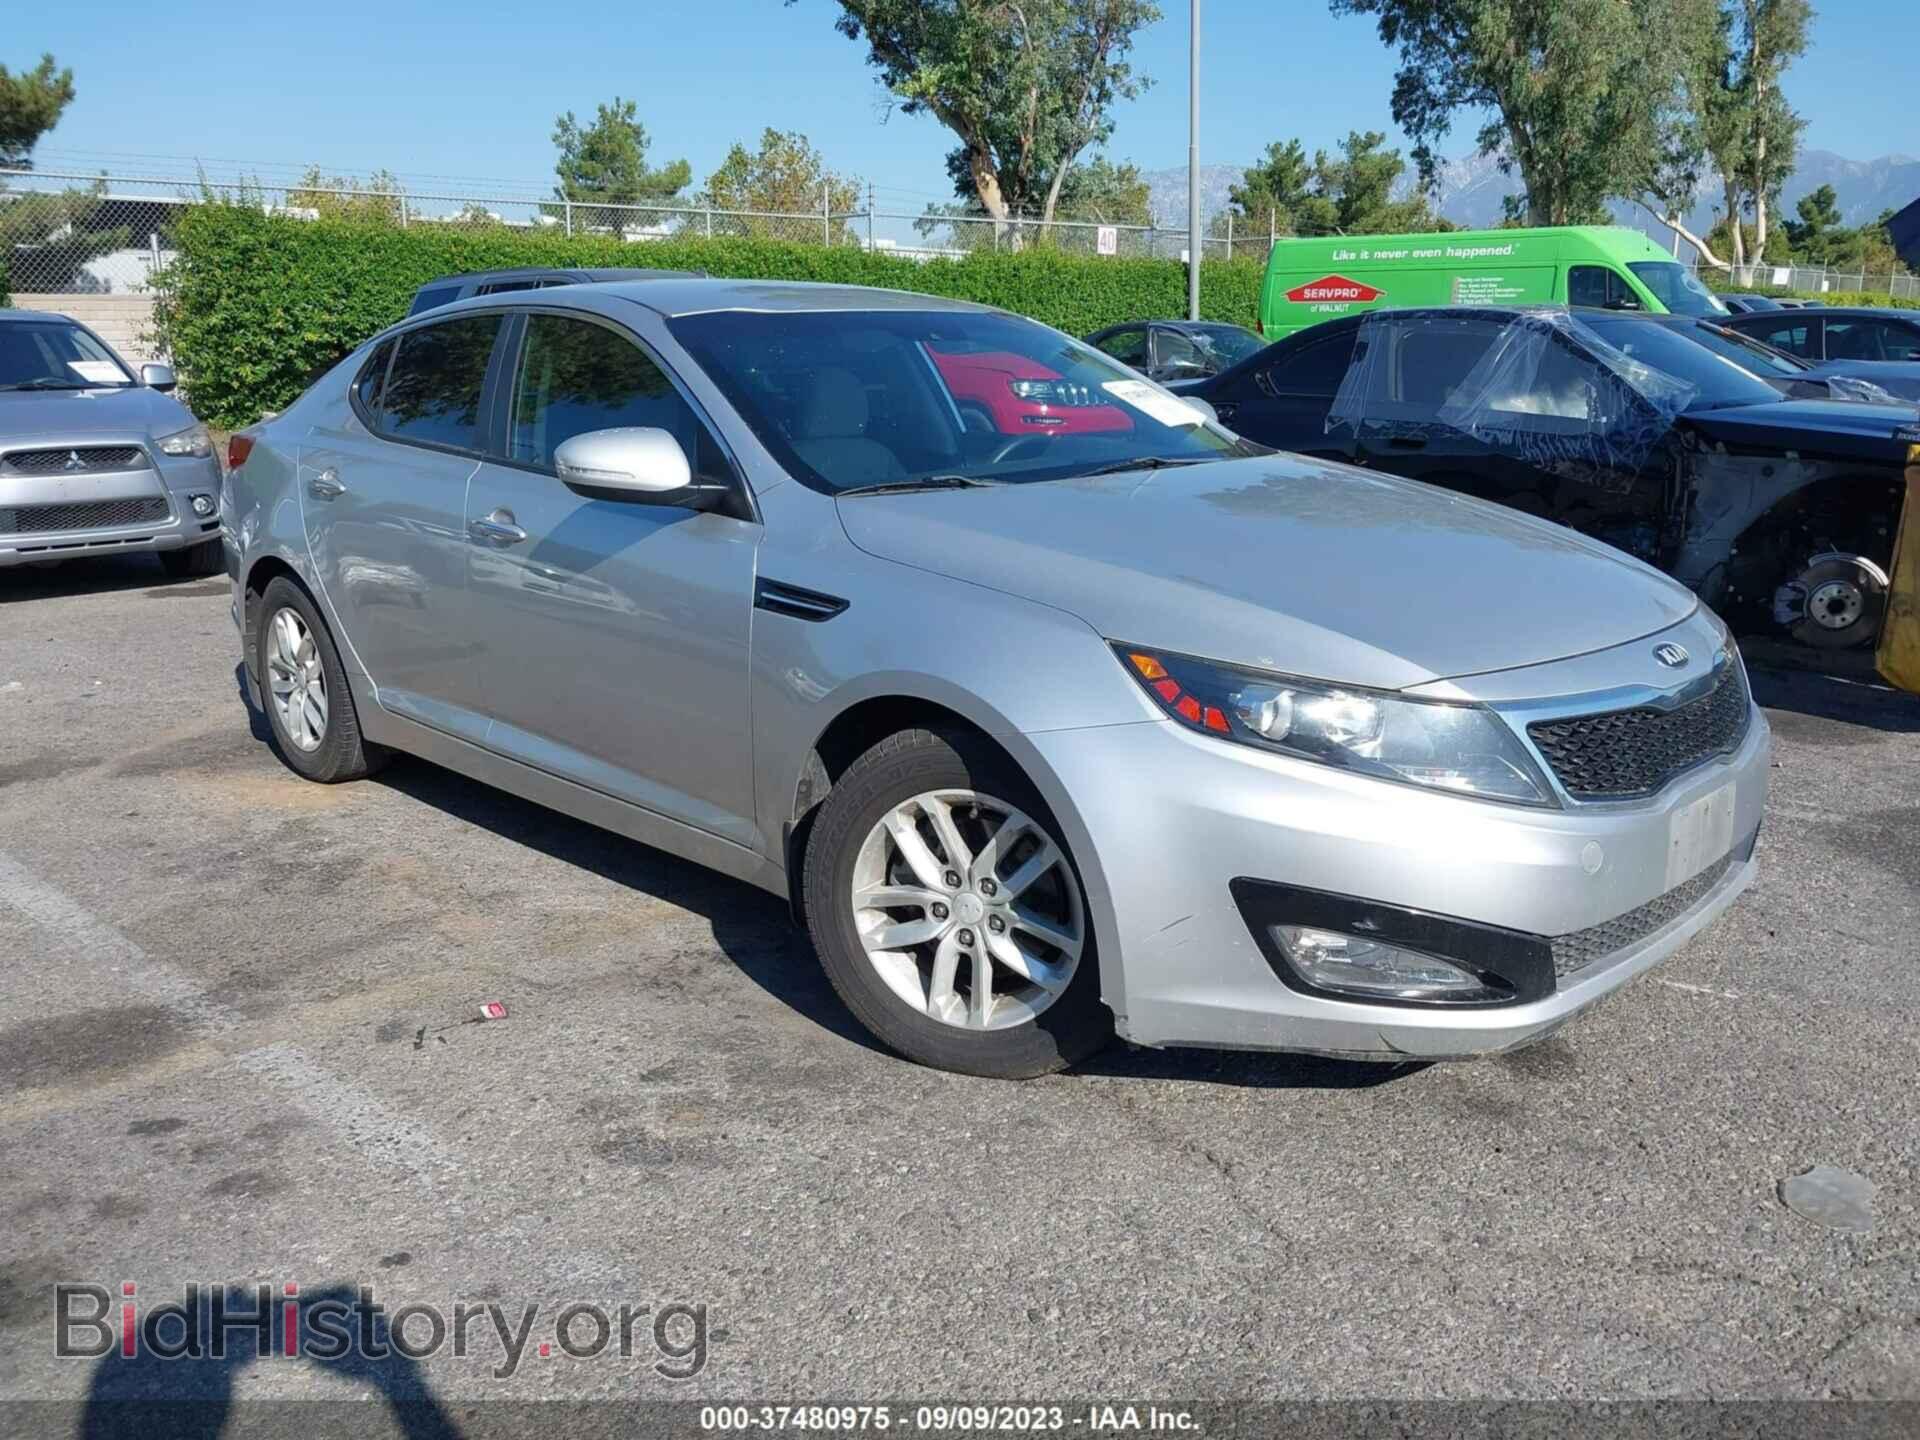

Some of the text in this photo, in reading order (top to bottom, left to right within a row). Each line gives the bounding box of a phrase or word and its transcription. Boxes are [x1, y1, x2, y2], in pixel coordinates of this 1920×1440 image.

[1100, 232, 1115, 250] 40
[1332, 250, 1356, 260] Like
[1360, 250, 1369, 259] it
[1374, 250, 1407, 259] never
[1412, 249, 1441, 258] even
[1310, 303, 1350, 313] of WALNUT
